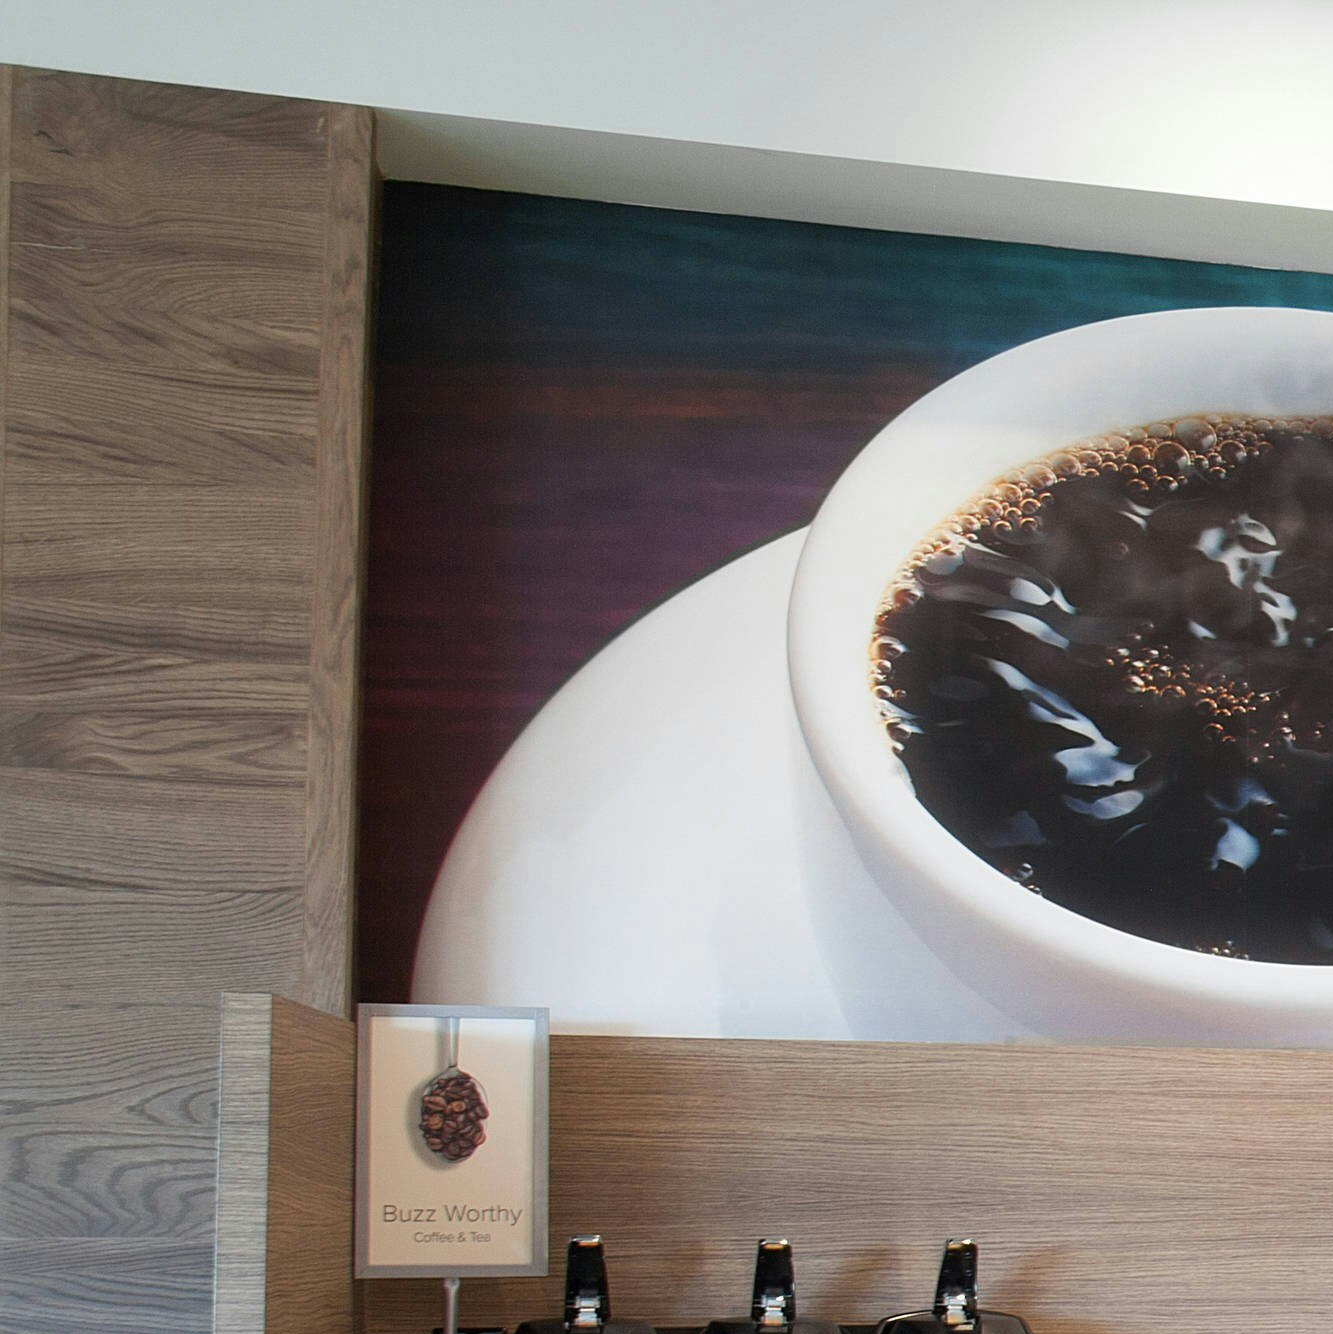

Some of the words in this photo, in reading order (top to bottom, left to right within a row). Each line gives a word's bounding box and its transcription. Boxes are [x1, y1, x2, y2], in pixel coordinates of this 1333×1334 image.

[382, 1204, 437, 1223] Buzz
[443, 1203, 524, 1227] Worthy
[413, 1231, 455, 1243] Coffee
[456, 1231, 466, 1243] &
[469, 1231, 492, 1243] Tea
